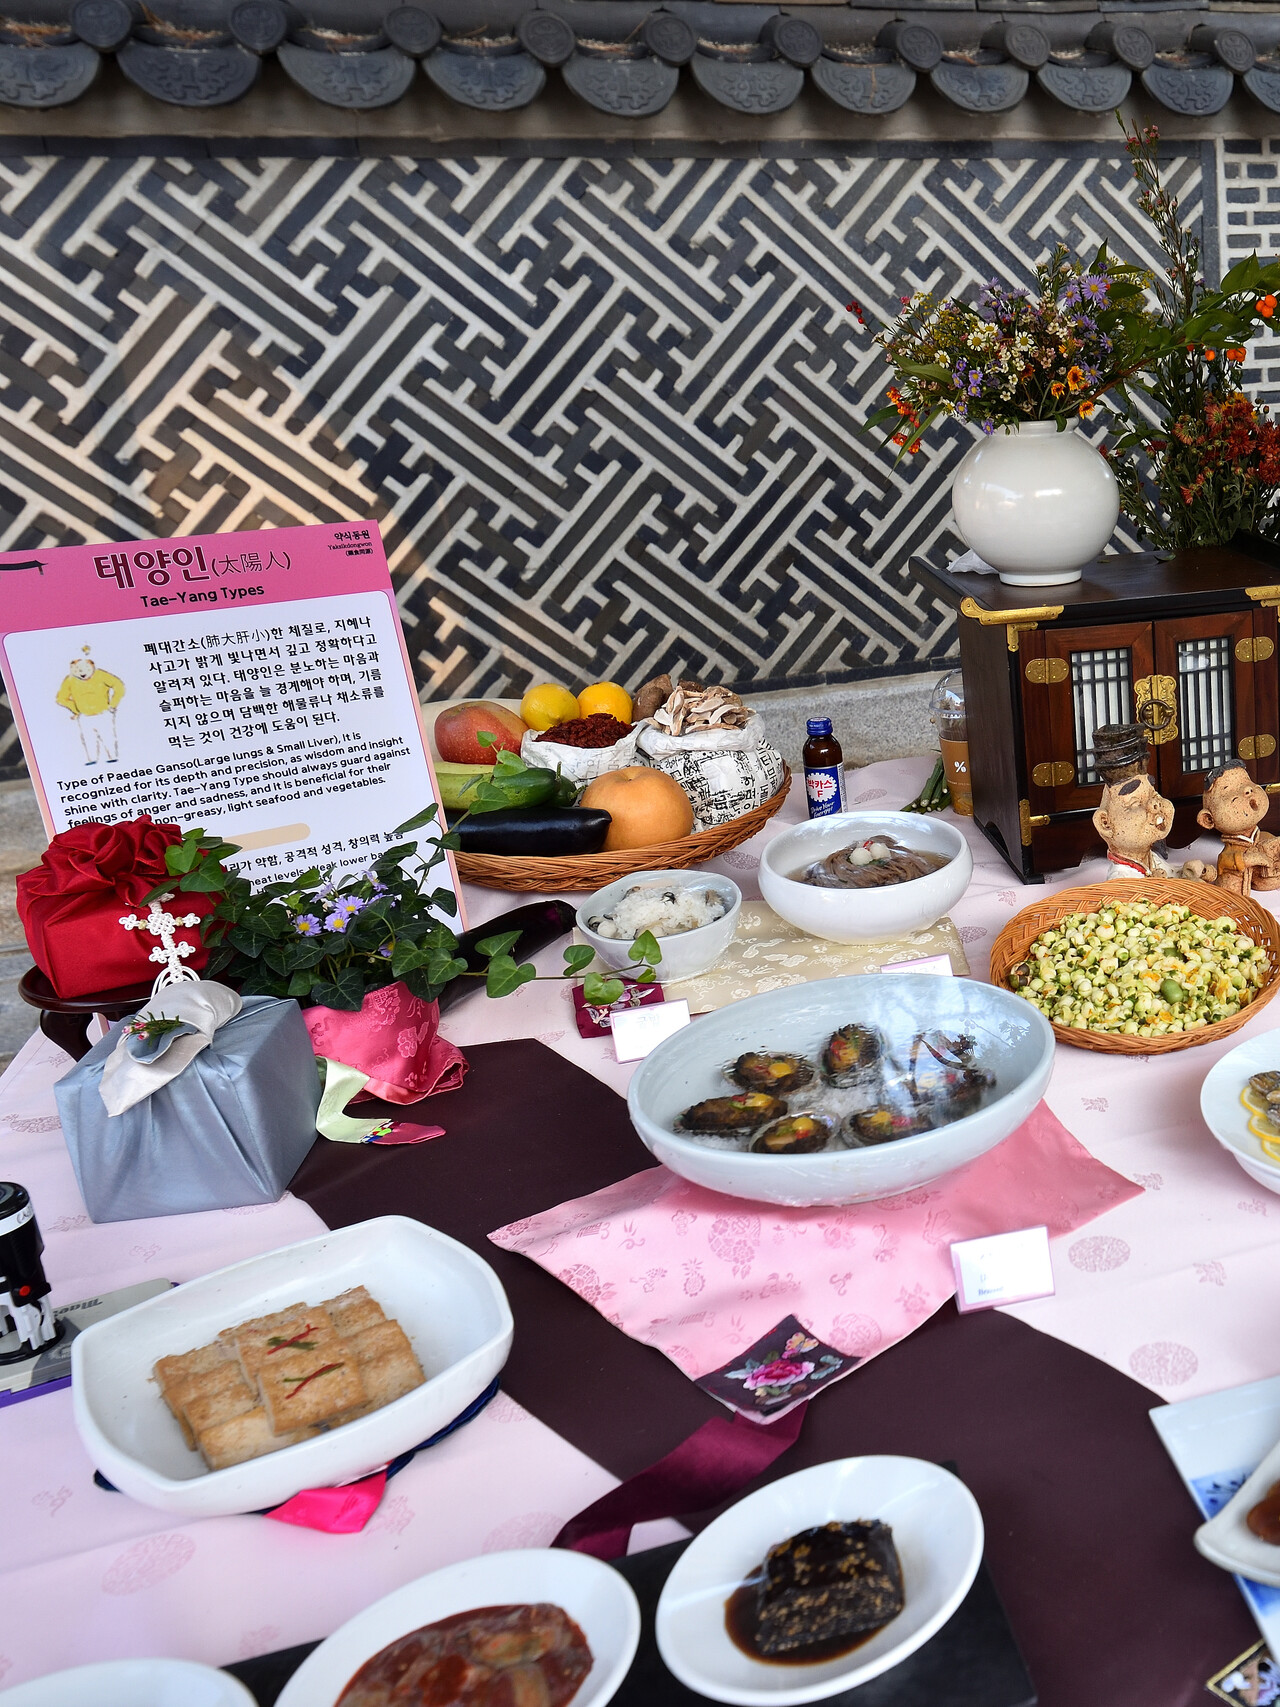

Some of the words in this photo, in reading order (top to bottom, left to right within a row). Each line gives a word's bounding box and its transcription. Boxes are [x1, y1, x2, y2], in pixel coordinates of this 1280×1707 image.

[139, 590, 218, 607] Tae-Yang
[219, 585, 264, 600] Types
[288, 622, 330, 637] 체질로,
[149, 657, 190, 674] 사고가
[194, 653, 223, 669] 밝게
[227, 645, 281, 665] 빛나면서
[285, 642, 311, 657] 깊고
[314, 633, 377, 653] 정확하다고
[153, 676, 196, 694] 알려져
[199, 672, 230, 687] 있다.
[233, 664, 285, 682] 태양인은
[290, 657, 339, 674] 분노하는
[342, 650, 379, 666] 마음과
[158, 693, 212, 712] 슬퍼하는
[215, 686, 255, 703] 마음을
[259, 685, 271, 697] 늘
[275, 676, 325, 695] 경계해야
[327, 672, 356, 686] 하며,
[358, 668, 381, 682] 기름
[163, 715, 191, 730] 지지
[194, 708, 235, 726] 않으며
[238, 701, 278, 719] 담백한
[282, 693, 332, 712] 해물류나
[336, 685, 384, 703] 채소류를
[167, 734, 195, 748] 먹는
[198, 728, 225, 744] 것이
[229, 721, 268, 739] 건강에
[271, 715, 309, 732] 도움이
[311, 711, 340, 726] 된다.
[56, 779, 88, 791] Type
[90, 773, 104, 785] of
[106, 768, 153, 782] Paedae
[265, 745, 275, 755] &
[276, 740, 306, 753] Small
[352, 731, 361, 740] is
[60, 782, 131, 803] recognized
[133, 780, 152, 790] for
[154, 777, 171, 787] its
[172, 770, 208, 784] depth
[210, 765, 232, 777] and
[234, 758, 288, 774] precision,
[290, 755, 302, 763] as
[303, 747, 345, 760] wisdom
[347, 742, 367, 753] and
[368, 736, 403, 749] insight
[64, 804, 97, 816] shine
[100, 797, 128, 809] with
[130, 791, 172, 804] clarity.
[172, 780, 231, 796] Tae-Yang
[232, 775, 260, 786] Type
[261, 766, 299, 781] should
[301, 760, 338, 774] always
[339, 753, 371, 768] guard
[373, 747, 411, 761] against
[227, 799, 254, 812] light
[255, 790, 301, 807] seafood
[303, 786, 323, 798] and
[325, 776, 386, 793] vegetables.
[807, 779, 833, 790] 박카스
[817, 790, 823, 798] F
[225, 859, 253, 875] 리가
[254, 854, 282, 868] 약함,
[284, 846, 318, 863] 공격적
[321, 840, 346, 855] 성격,
[347, 833, 380, 849] 창의력
